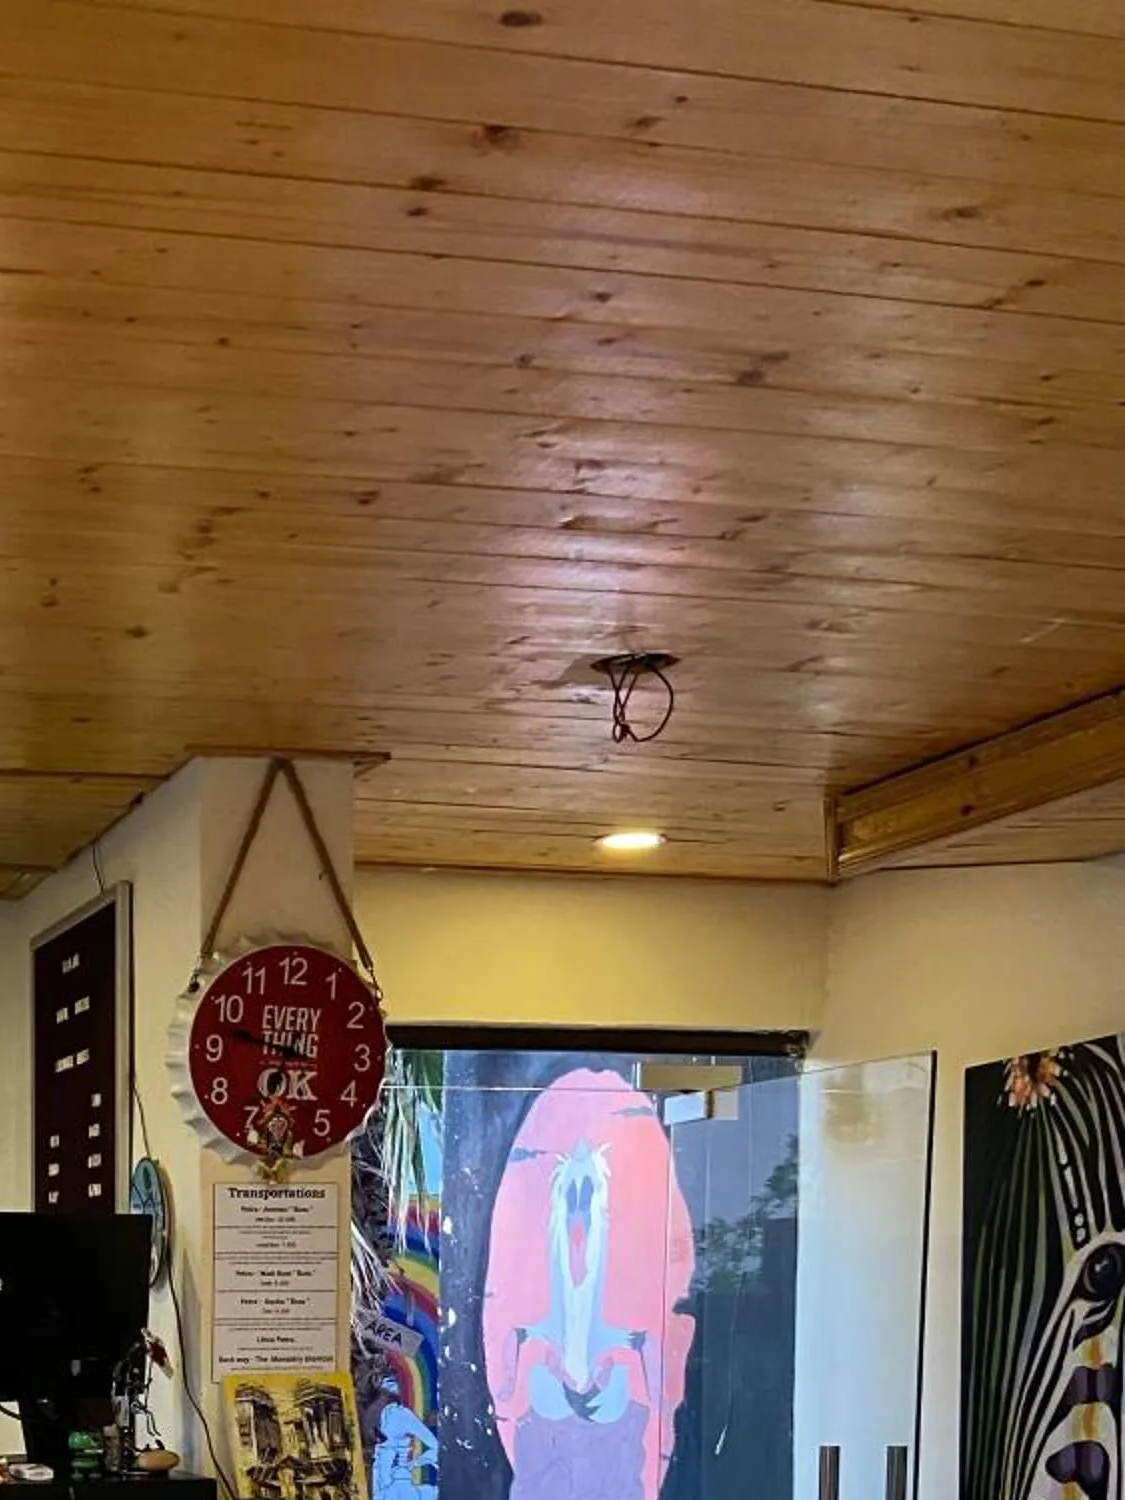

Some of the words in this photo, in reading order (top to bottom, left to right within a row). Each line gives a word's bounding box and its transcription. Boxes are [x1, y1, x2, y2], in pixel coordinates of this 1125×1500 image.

[242, 966, 267, 996] 11
[278, 957, 308, 986] 12
[325, 972, 337, 1000] 1
[214, 994, 244, 1024] 10
[262, 1004, 322, 1032] EVERY
[346, 1001, 364, 1029] 2
[205, 1034, 223, 1063] 9
[353, 1044, 371, 1072] 3
[210, 1077, 228, 1105] 8
[257, 1068, 318, 1101] OK
[340, 1081, 357, 1108] 4
[243, 1106, 259, 1130] 7
[313, 1109, 331, 1137] 5
[228, 1187, 326, 1201] Transportations
